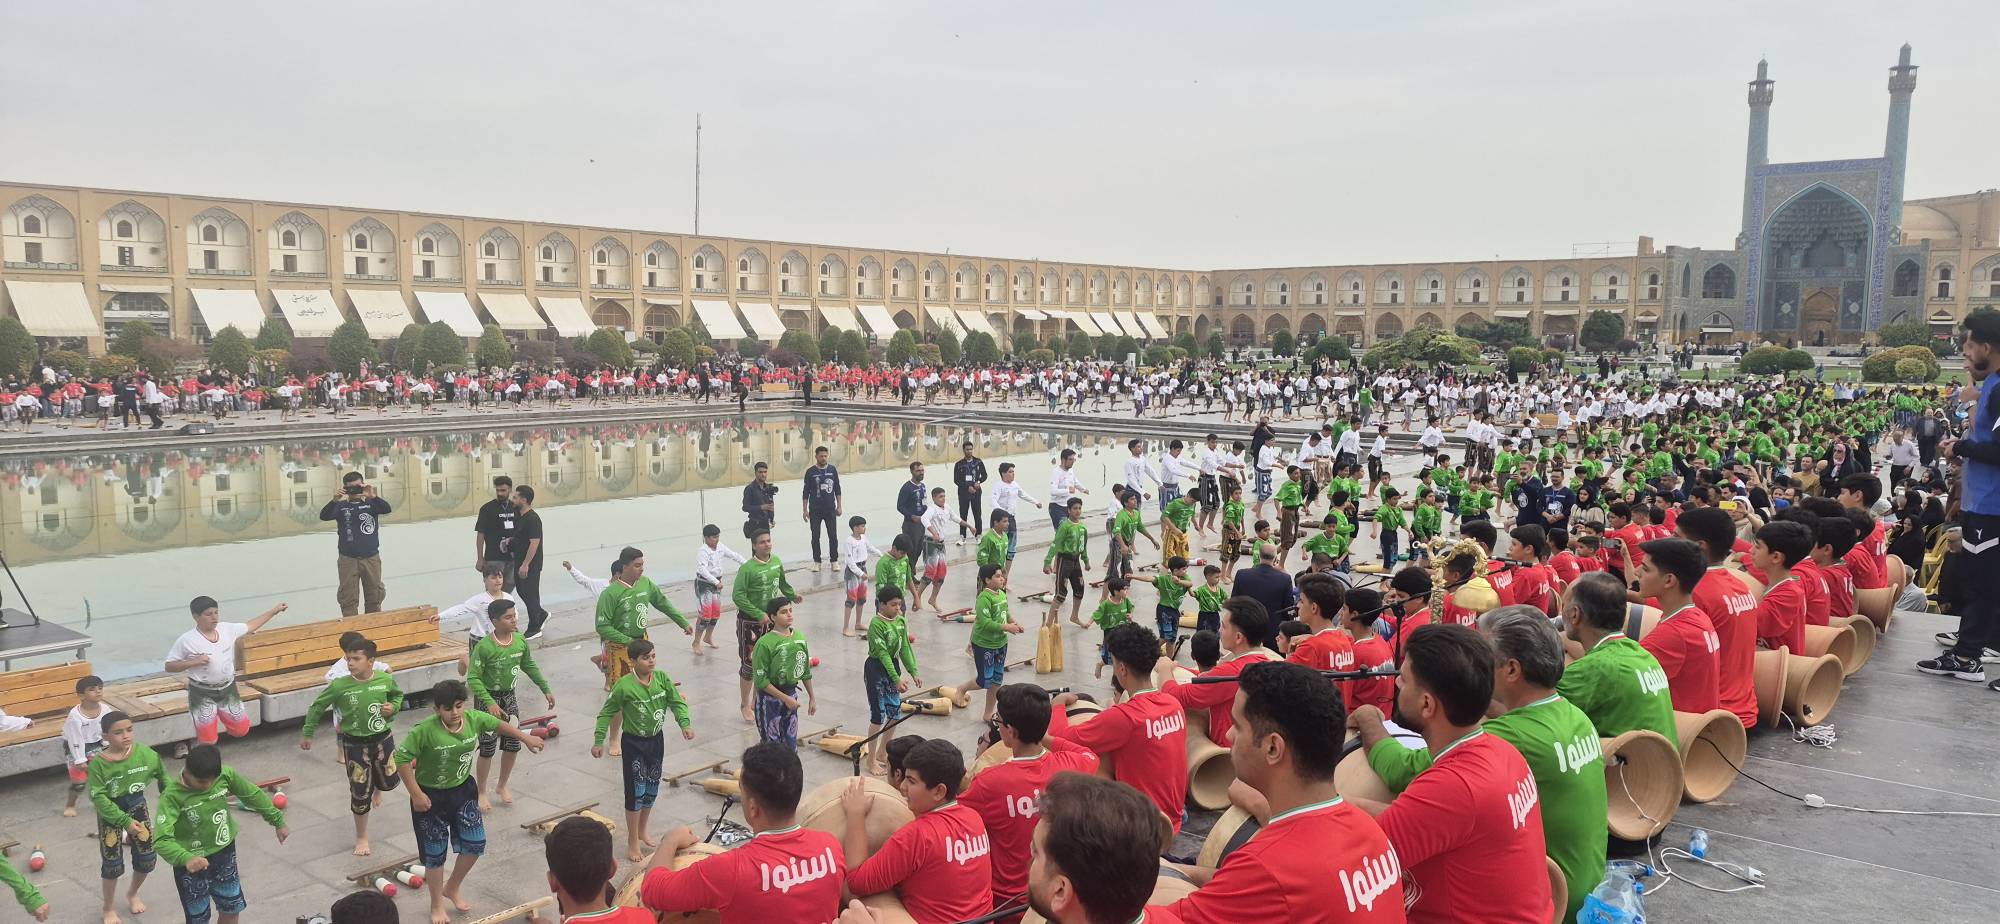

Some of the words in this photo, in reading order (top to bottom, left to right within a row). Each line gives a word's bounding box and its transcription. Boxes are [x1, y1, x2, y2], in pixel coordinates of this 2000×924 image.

[1146, 710, 1185, 740] اسنوا
[1553, 726, 1602, 775] اسنوا
[761, 846, 837, 894] اسنوا
